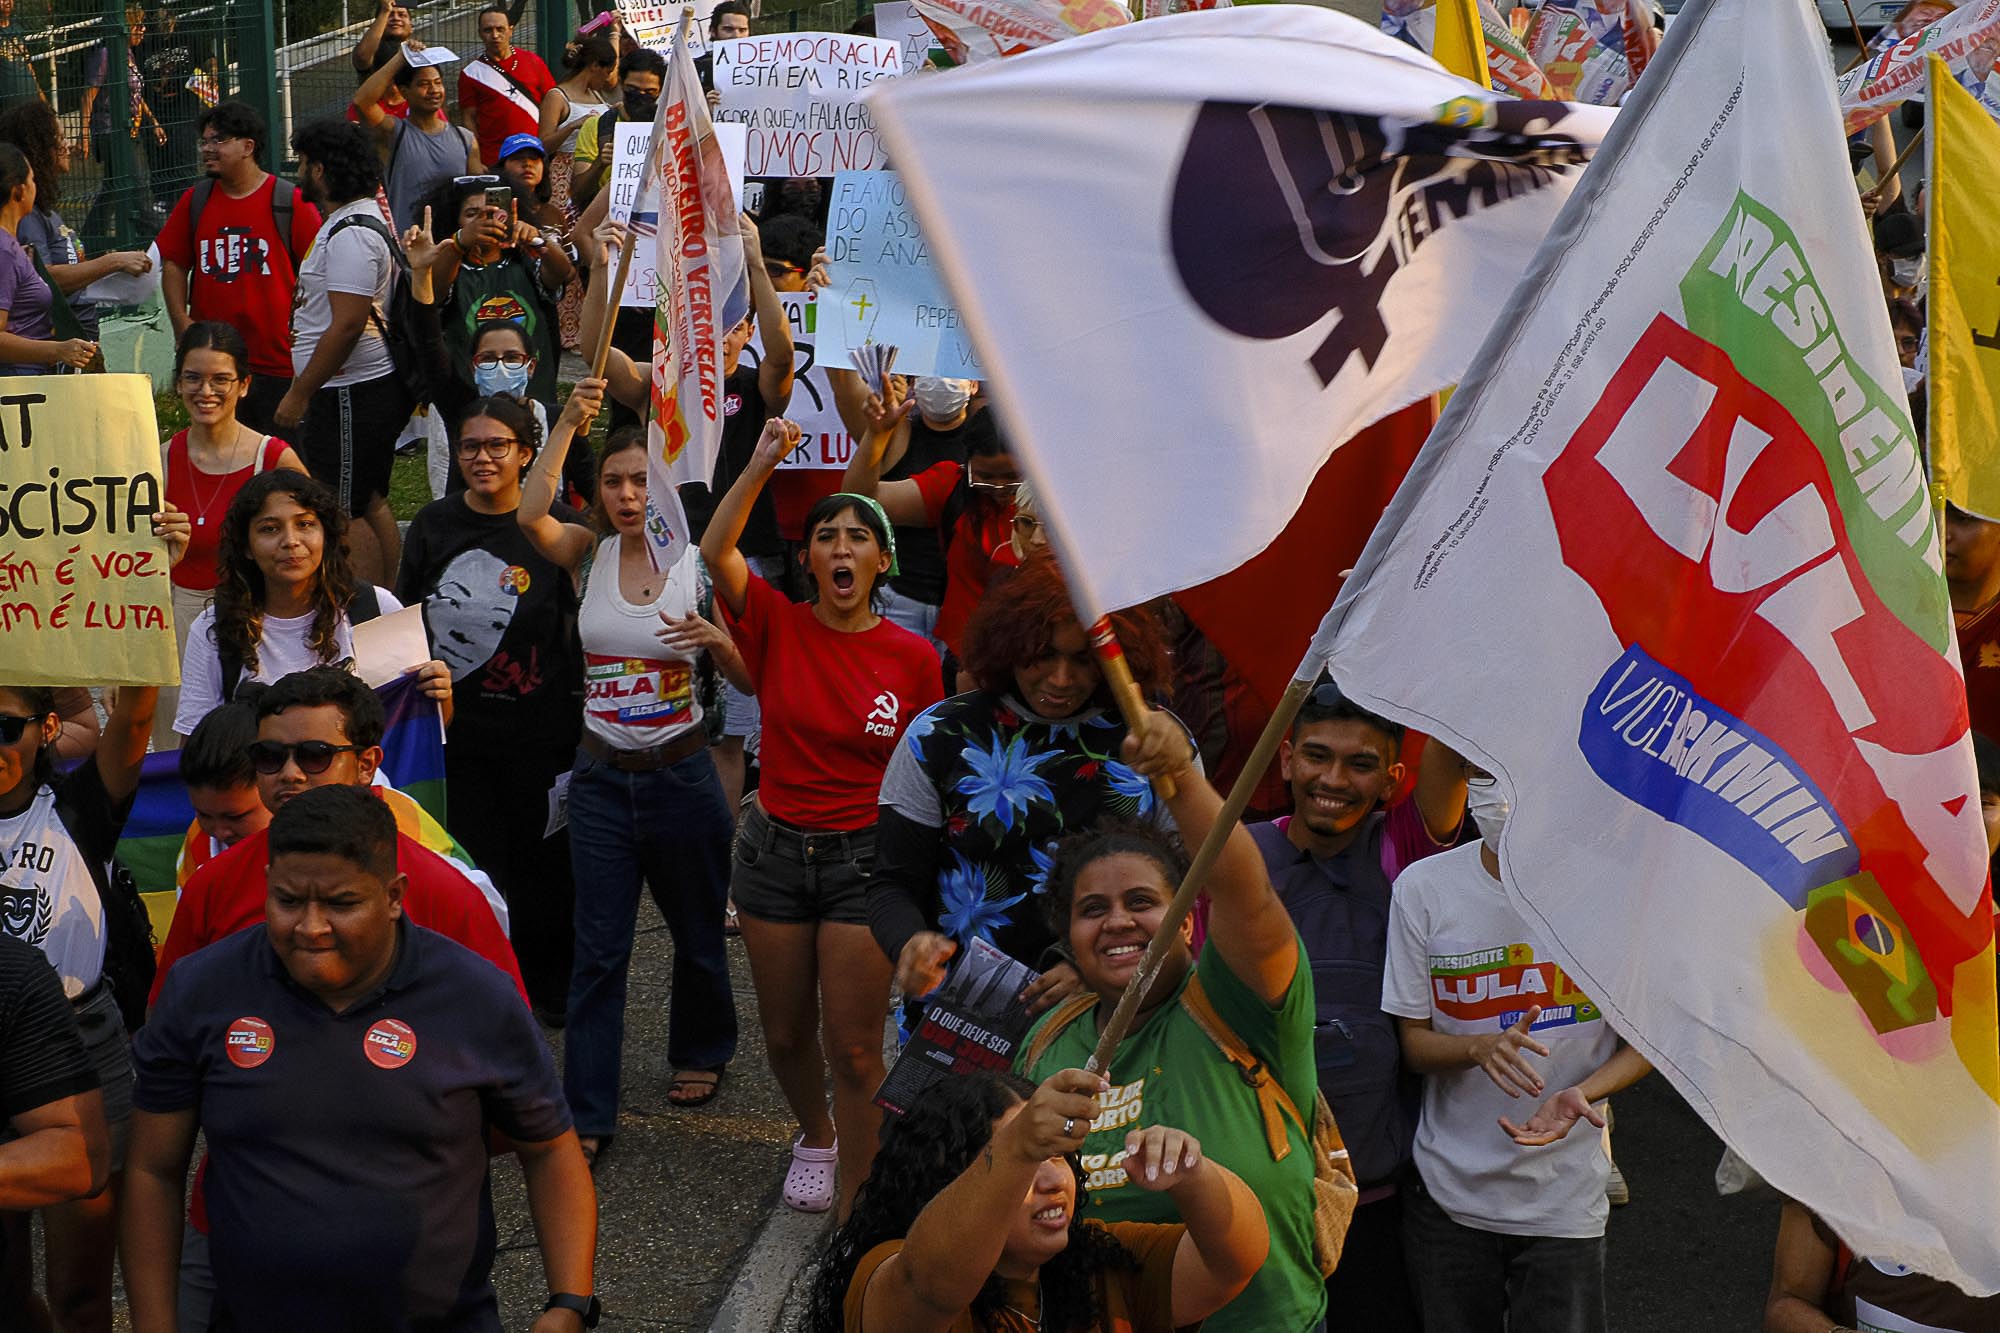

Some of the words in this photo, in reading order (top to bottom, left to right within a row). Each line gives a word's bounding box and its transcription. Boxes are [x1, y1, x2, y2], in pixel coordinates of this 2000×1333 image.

[716, 46, 730, 65] A
[738, 38, 899, 69] DEMOCRACIA
[1486, 46, 1544, 97] ULA
[732, 61, 780, 88] ESTÁ
[786, 66, 823, 88] EM
[764, 107, 807, 130] QUEM
[745, 128, 823, 177] OMOS
[664, 99, 707, 259] BANZEIRO
[836, 207, 867, 233] DO
[834, 234, 862, 263] DE
[686, 263, 717, 422] VERMELHO
[1523, 418, 1544, 446] CNPJ
[1540, 379, 1567, 418] Gráfica:
[1448, 508, 1470, 532] Pronto
[54, 543, 81, 586] É
[50, 591, 76, 630] É
[85, 600, 170, 632] LUTA.
[1595, 356, 1990, 918] LULA
[1599, 659, 1686, 758] VICE
[864, 721, 896, 738] PCBR
[1431, 948, 1504, 970] PRESIDENTE
[1434, 967, 1549, 1004] LULA
[929, 1006, 942, 1022] O
[939, 1012, 964, 1032] QUE
[960, 1021, 990, 1047] DEVE
[986, 1034, 1012, 1056] SER
